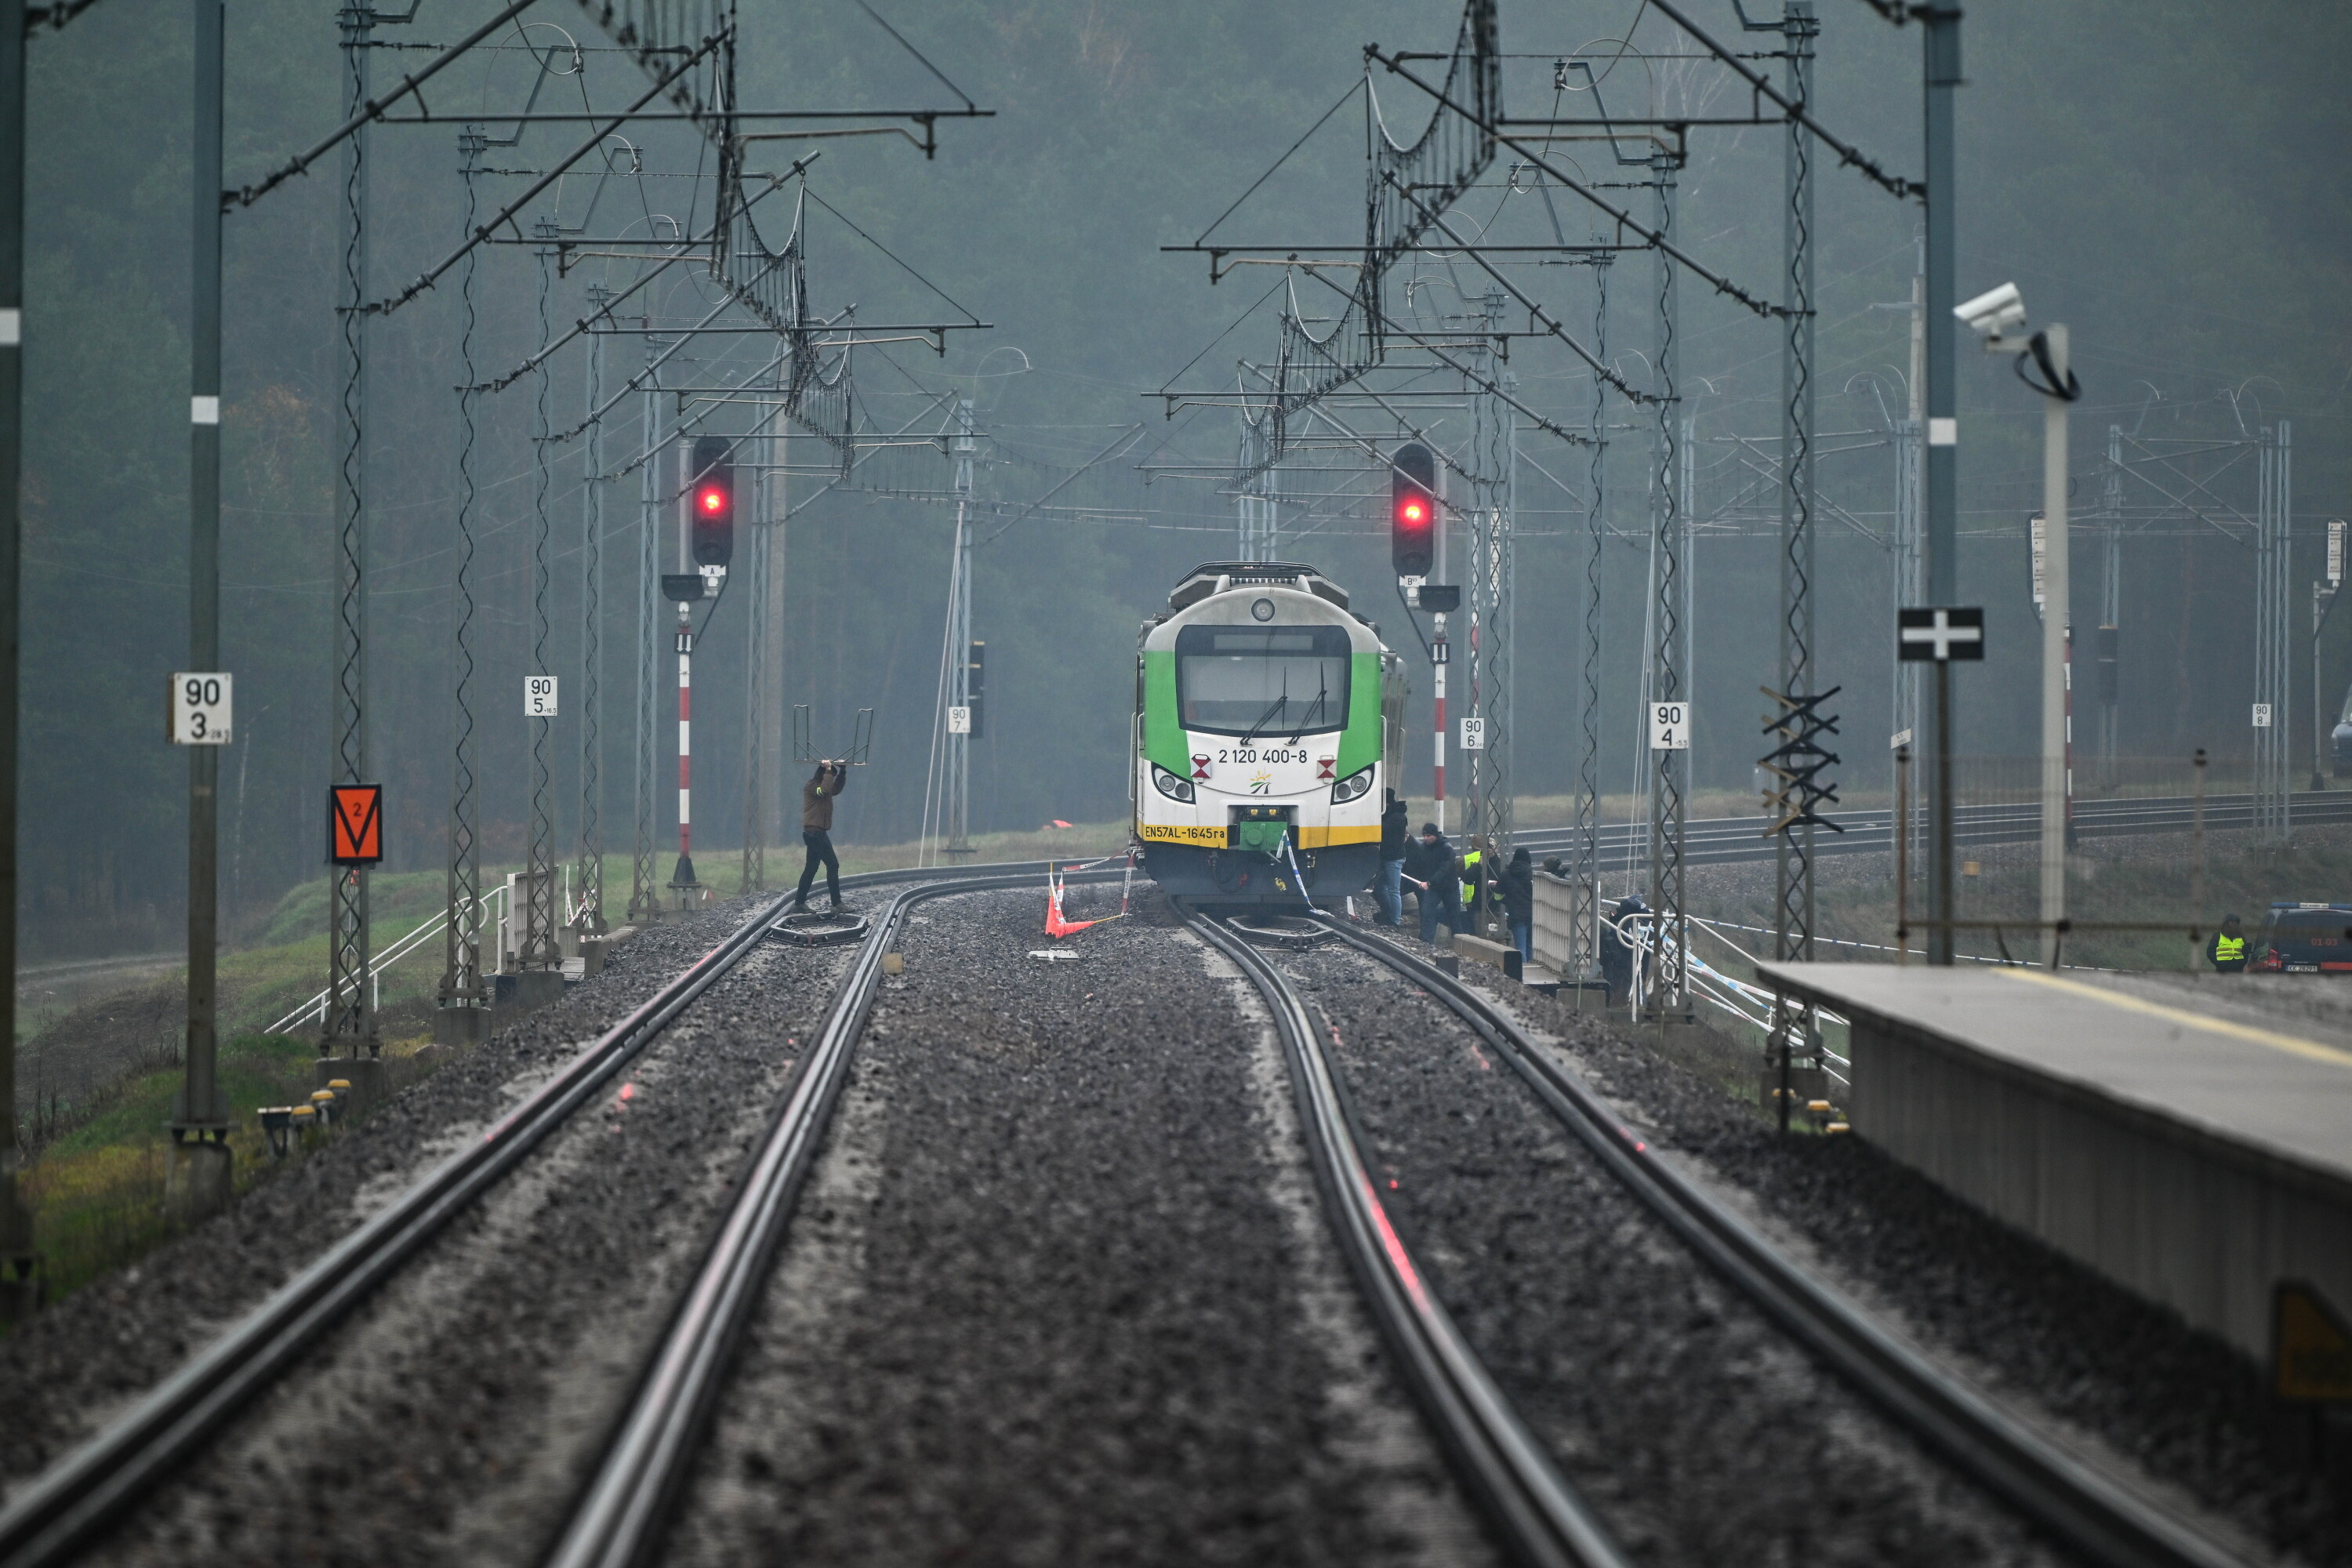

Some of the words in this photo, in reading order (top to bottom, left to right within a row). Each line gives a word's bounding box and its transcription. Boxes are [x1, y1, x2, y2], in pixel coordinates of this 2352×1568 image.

[710, 567, 715, 575] A
[186, 678, 220, 706] 90
[531, 679, 551, 695] 90
[534, 698, 543, 713] 5
[2256, 706, 2267, 714] 90
[953, 709, 965, 719] 90
[1658, 706, 1681, 724] 90
[2257, 716, 2263, 725] 8
[191, 711, 206, 739] 3
[954, 720, 960, 731] 7
[1465, 720, 1481, 732] 90
[1468, 735, 1475, 746] 6
[1661, 728, 1672, 746] 4
[1218, 750, 1228, 764] 2
[1232, 750, 1257, 764] 120
[1261, 750, 1308, 764] 400-8
[354, 802, 362, 817] 2
[1145, 826, 1225, 839] EN57AL-1645ra
